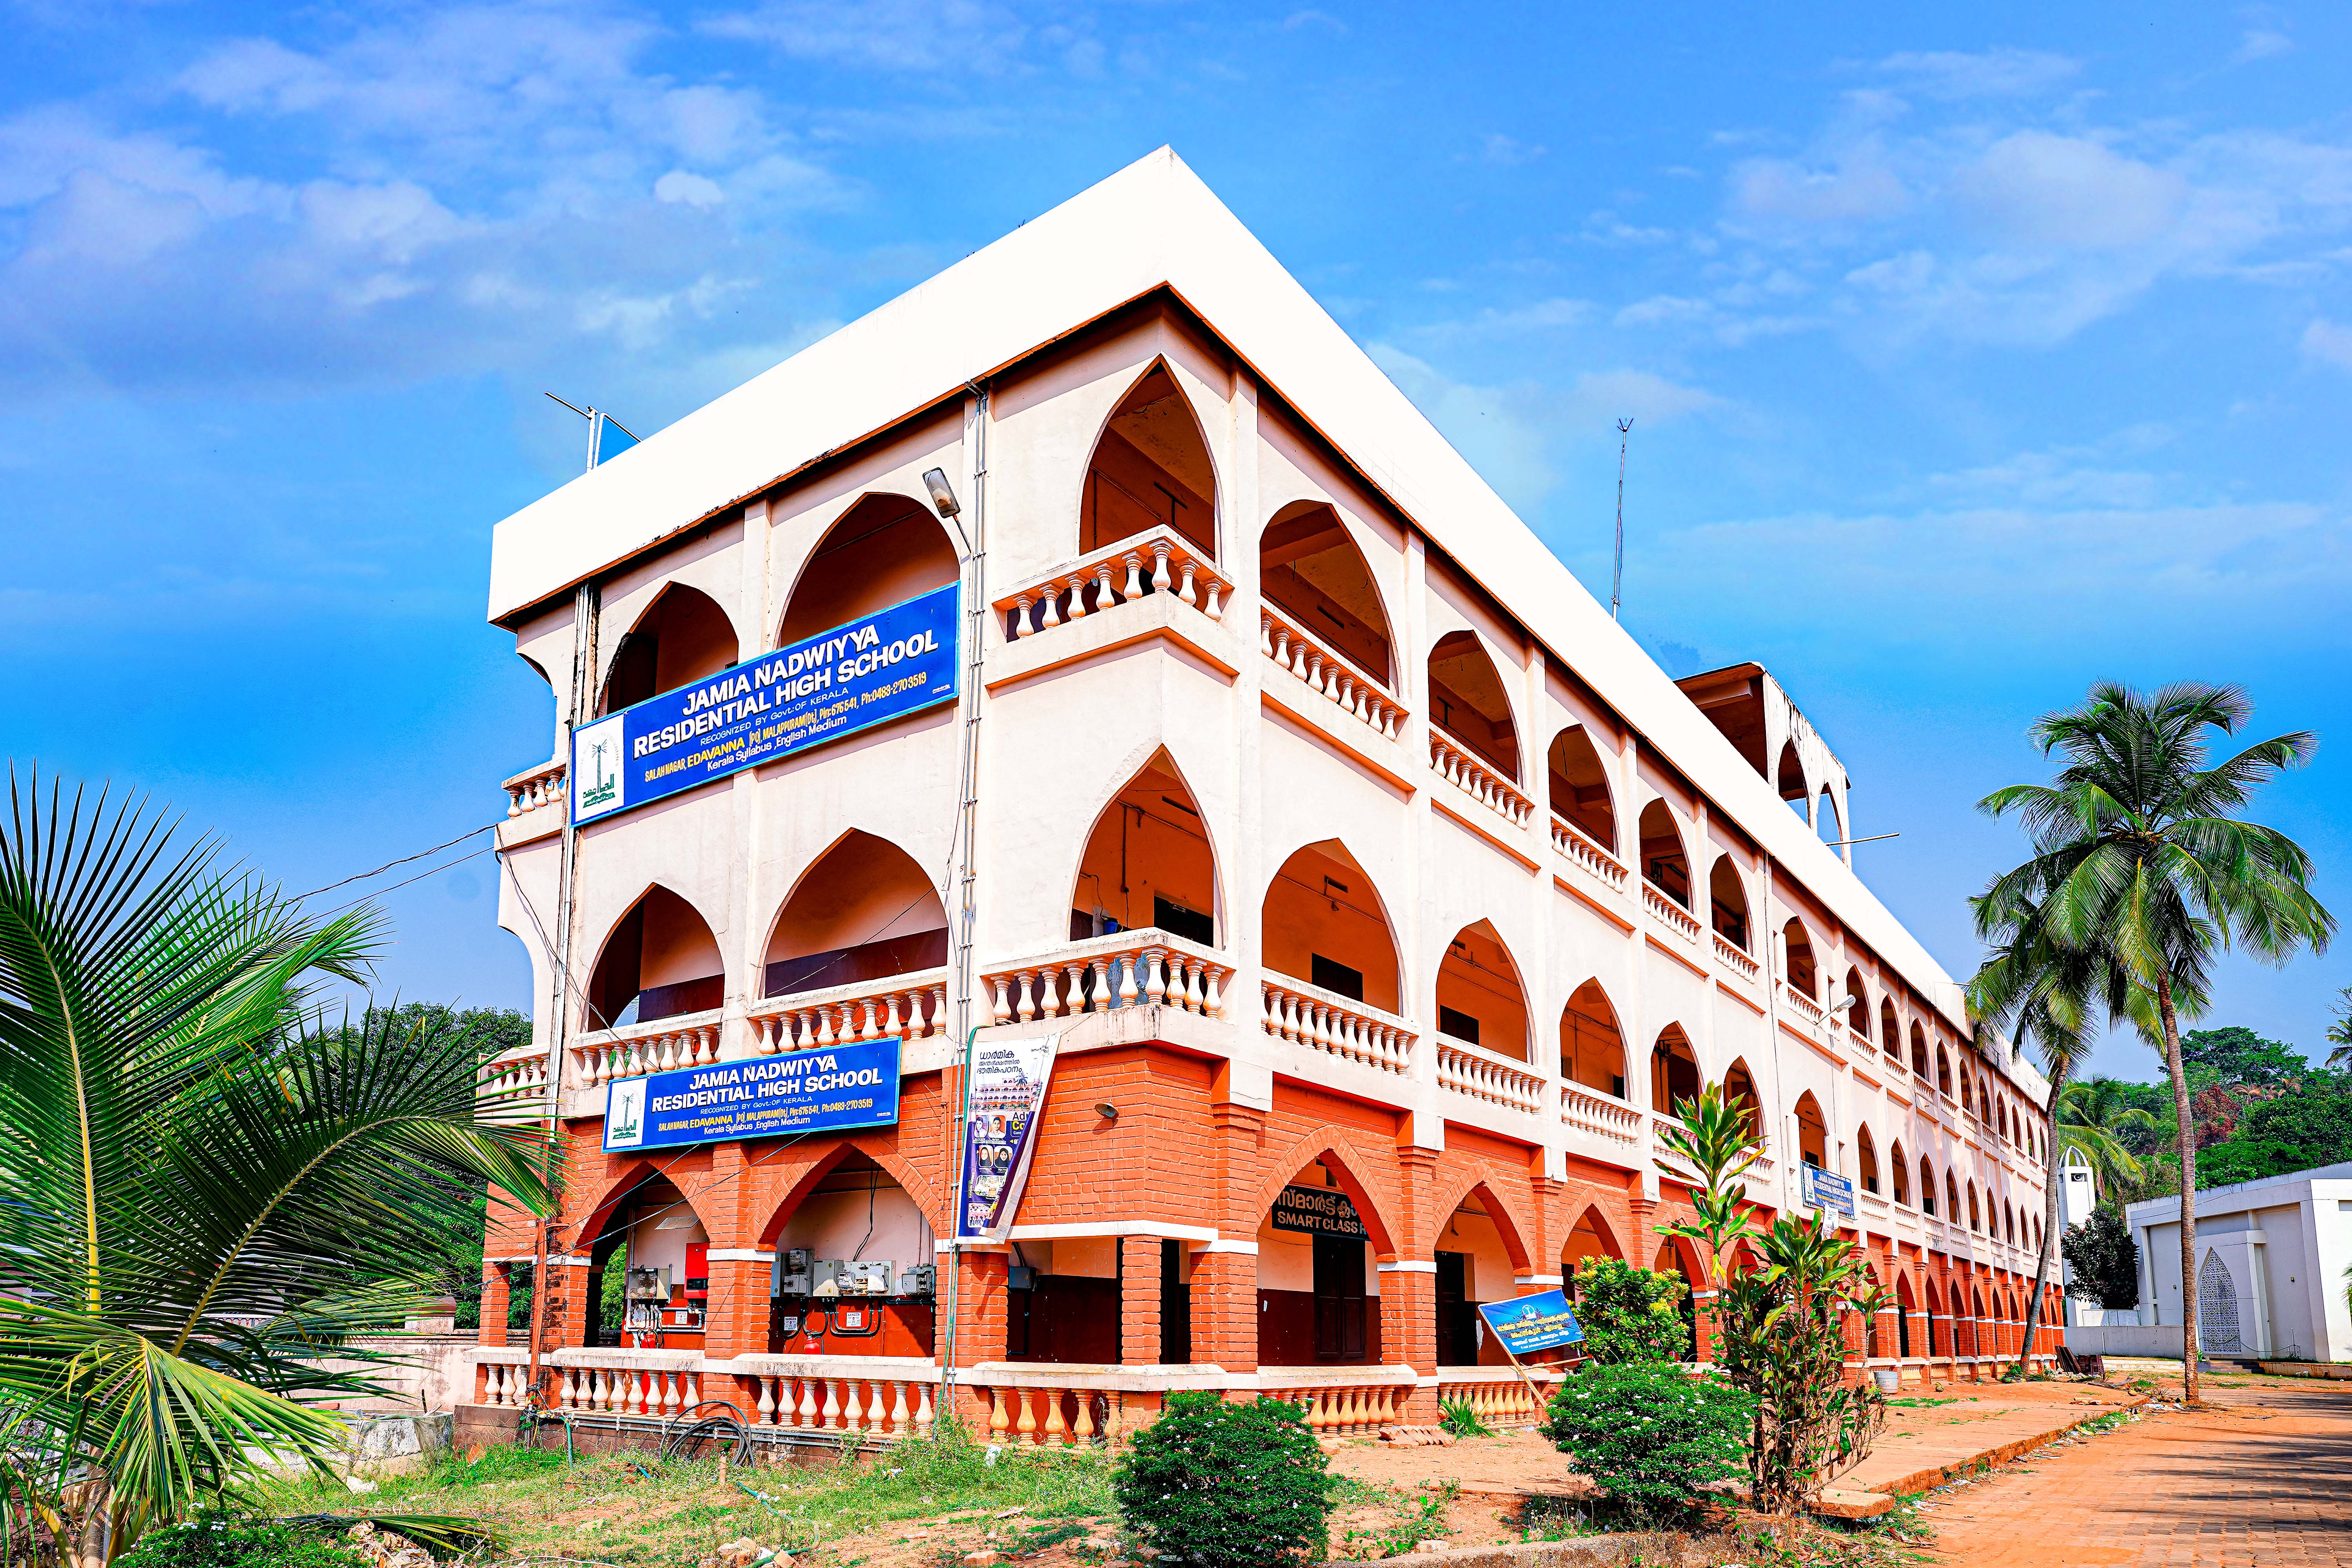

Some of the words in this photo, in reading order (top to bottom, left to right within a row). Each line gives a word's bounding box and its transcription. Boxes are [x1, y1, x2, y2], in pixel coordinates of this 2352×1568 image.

[682, 673, 751, 716] JAMIA
[754, 624, 880, 690] NADWIYYA
[633, 691, 771, 760] RESIDENTIAL
[775, 667, 831, 706] HIGH
[837, 629, 938, 684] SCHOOL
[700, 722, 751, 746] RECOGNIZED
[755, 715, 768, 726] BY
[810, 687, 849, 706] KERALA
[687, 737, 744, 768] EDAVANNA
[707, 755, 734, 772] Kerala
[735, 741, 772, 762] Syllabus
[808, 716, 847, 735] Medium
[689, 1069, 740, 1090] JAMIA
[743, 1054, 838, 1083] NADWIYYA
[652, 1085, 755, 1113] RESIDENTIAL
[757, 1078, 800, 1098] HIGH
[804, 1068, 883, 1093] SCHOOL
[700, 1105, 739, 1115] RECOGNIZED
[783, 1096, 813, 1104] KERALA
[690, 1115, 733, 1128] EDAVANNA
[704, 1125, 724, 1135] Kerala
[725, 1123, 753, 1134] Syllabus
[780, 1116, 810, 1126] Medium
[1278, 1211, 1322, 1229] SMART
[1323, 1218, 1358, 1234] CLASS
